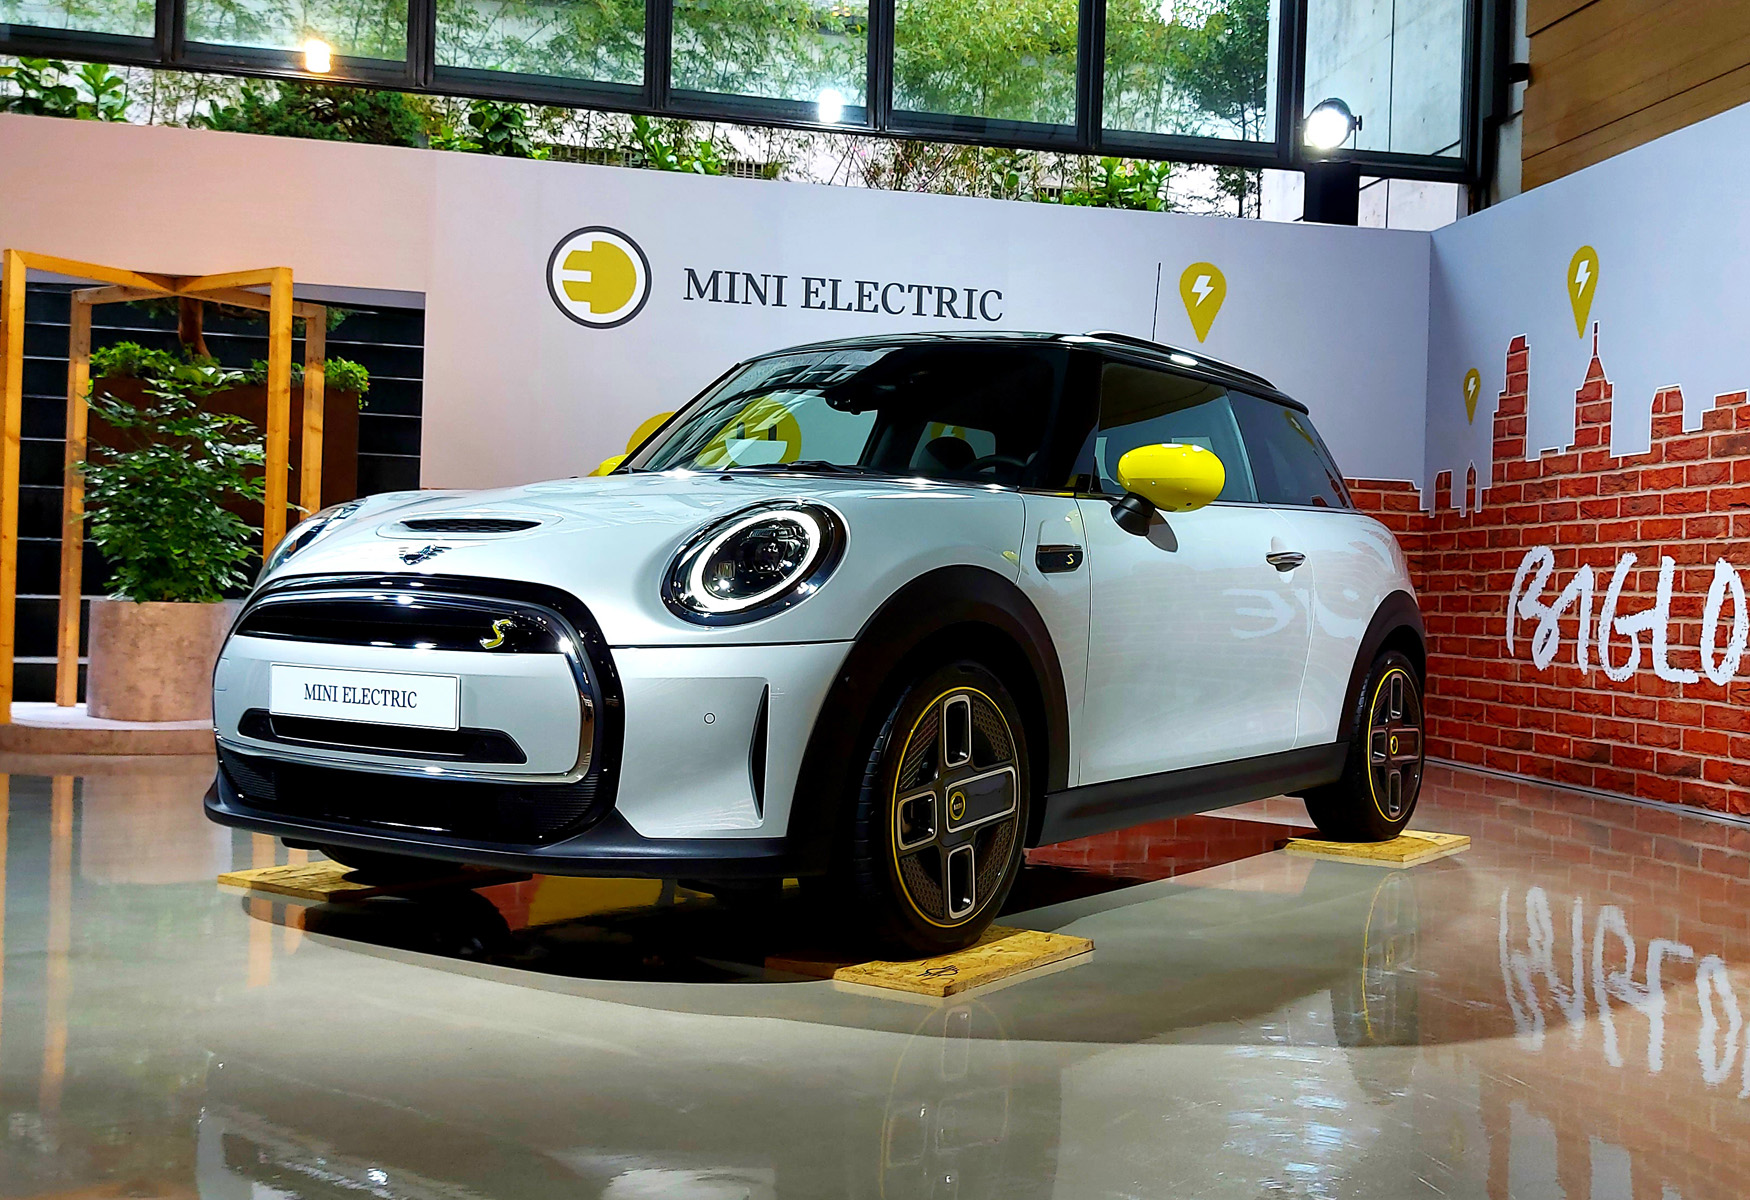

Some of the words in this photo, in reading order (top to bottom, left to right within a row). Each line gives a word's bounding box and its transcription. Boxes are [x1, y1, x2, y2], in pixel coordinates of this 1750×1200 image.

[683, 267, 787, 307] MINI
[800, 276, 1003, 321] ELECTRIC
[1066, 553, 1074, 565] S
[479, 619, 512, 649] S
[304, 683, 338, 702] MINI
[342, 686, 417, 708] ELECTRIC
